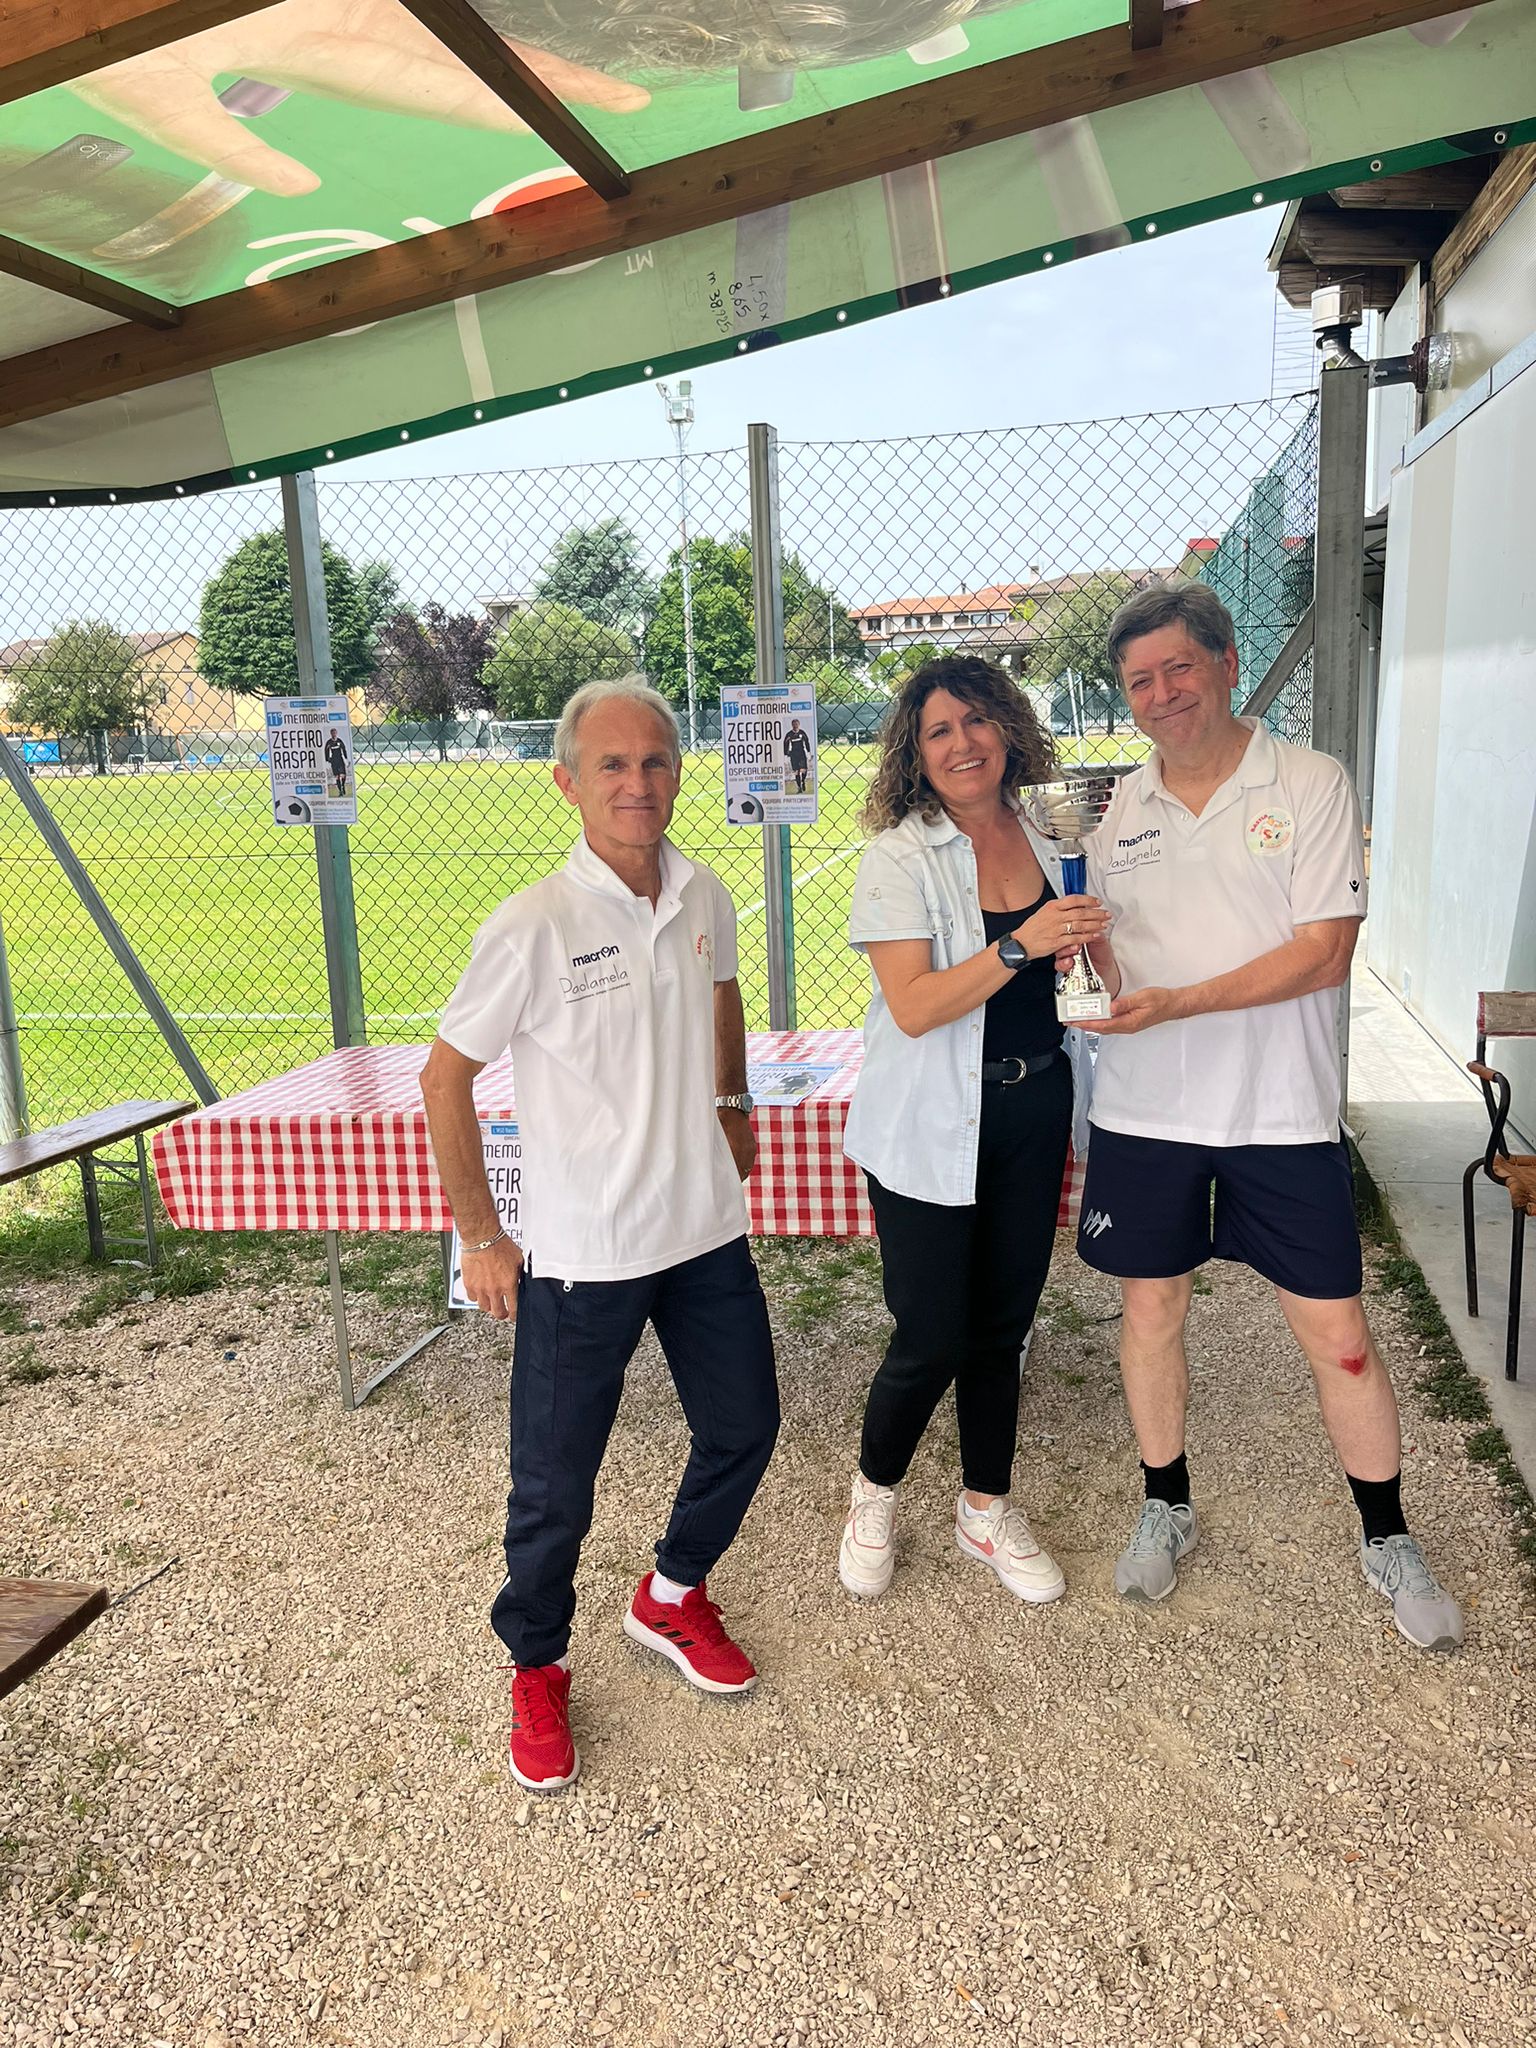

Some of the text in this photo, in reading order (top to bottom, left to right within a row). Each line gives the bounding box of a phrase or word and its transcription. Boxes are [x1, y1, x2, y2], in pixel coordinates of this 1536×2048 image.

[740, 702, 792, 715] MEMORIAL
[284, 713, 330, 725] MEMORIAL
[272, 729, 323, 749] ZEFFIRO
[727, 720, 782, 742] ZEFFIRO
[273, 750, 317, 770] RASPA
[728, 743, 772, 765] RASPA
[728, 766, 783, 776] OSPEDALICCHIO
[1118, 829, 1161, 847] macron
[572, 945, 620, 967] macron
